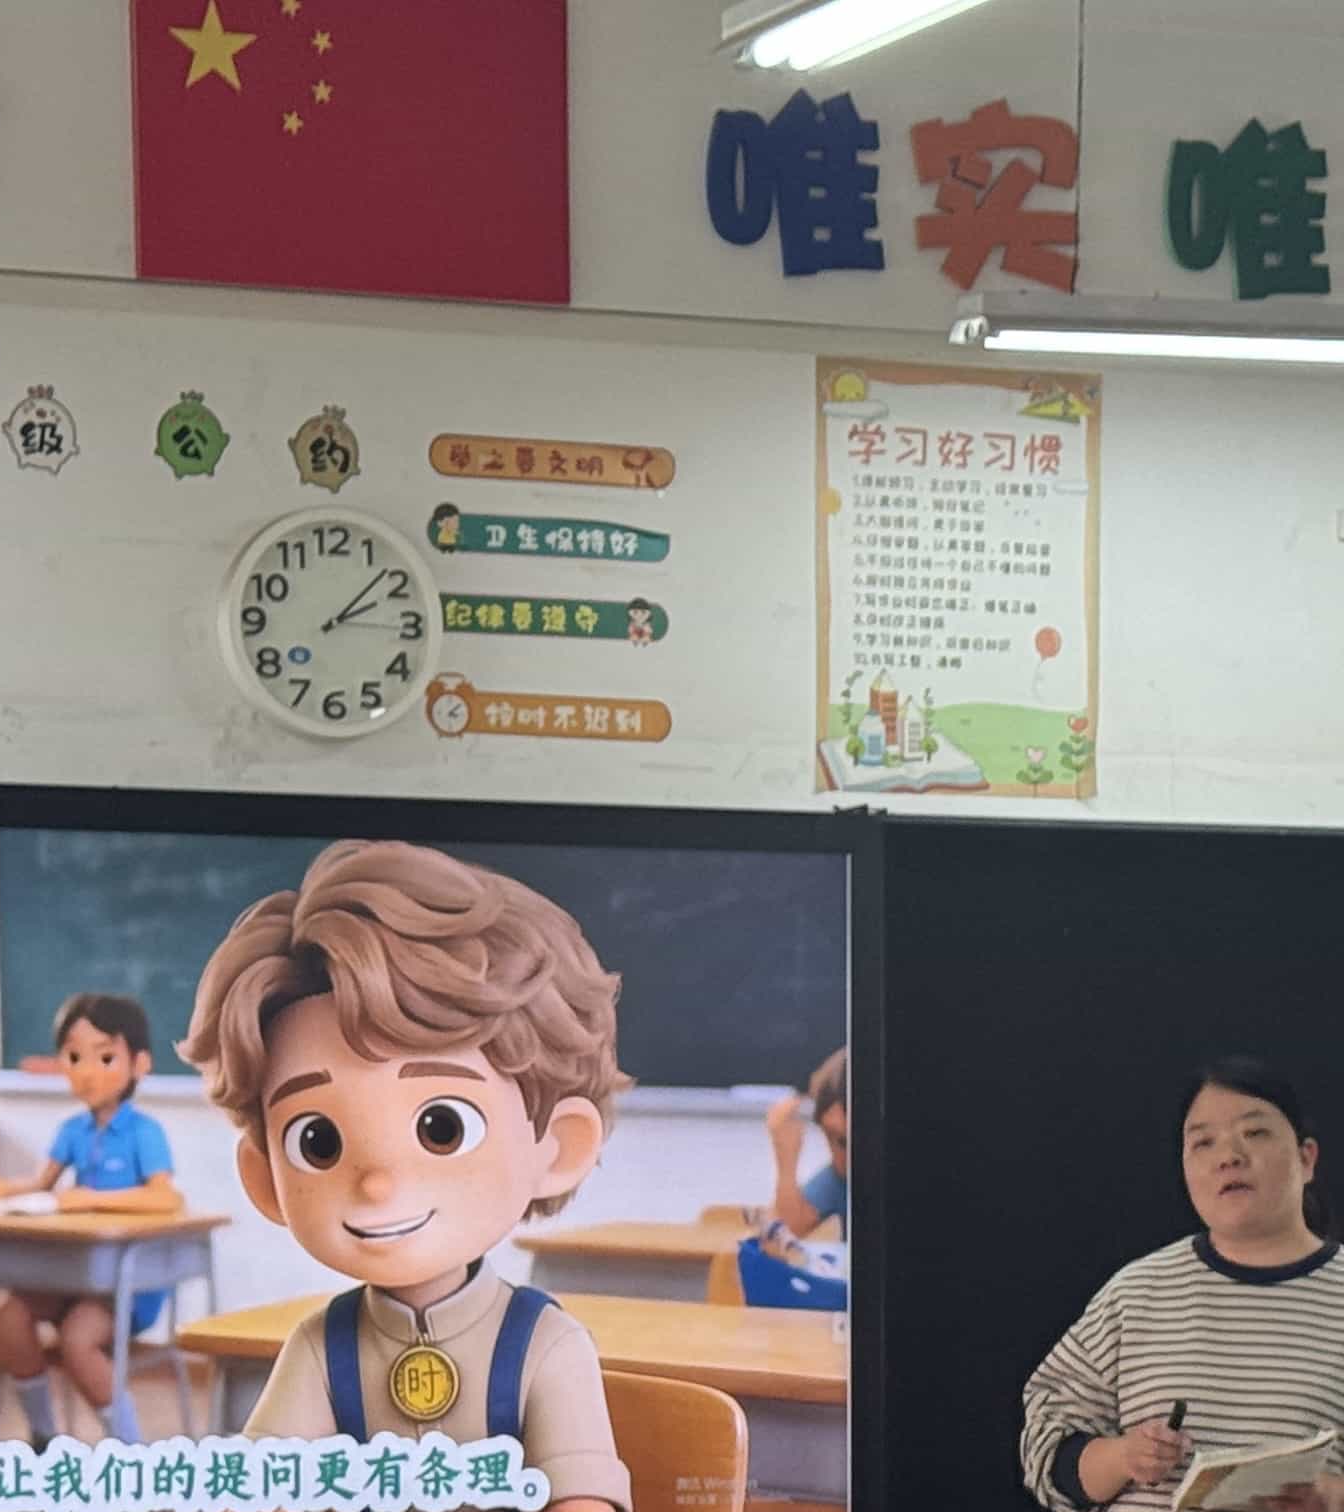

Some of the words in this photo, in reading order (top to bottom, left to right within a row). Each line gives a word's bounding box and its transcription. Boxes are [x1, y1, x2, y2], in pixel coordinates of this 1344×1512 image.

[20, 421, 63, 455] 级
[172, 425, 208, 460] 公
[310, 436, 350, 473] 约
[847, 423, 1064, 474] 学习好习惯
[276, 540, 306, 570] 11
[312, 525, 351, 557] 12
[361, 538, 373, 567] 1
[251, 573, 289, 602] 10
[387, 569, 410, 599] 2
[241, 606, 267, 635] 9
[399, 611, 423, 641] 3
[256, 647, 283, 679] 8
[384, 651, 410, 682] 4
[288, 678, 311, 708] 7
[322, 690, 347, 720] 6
[359, 681, 383, 710] 5
[407, 1359, 441, 1403] 时
